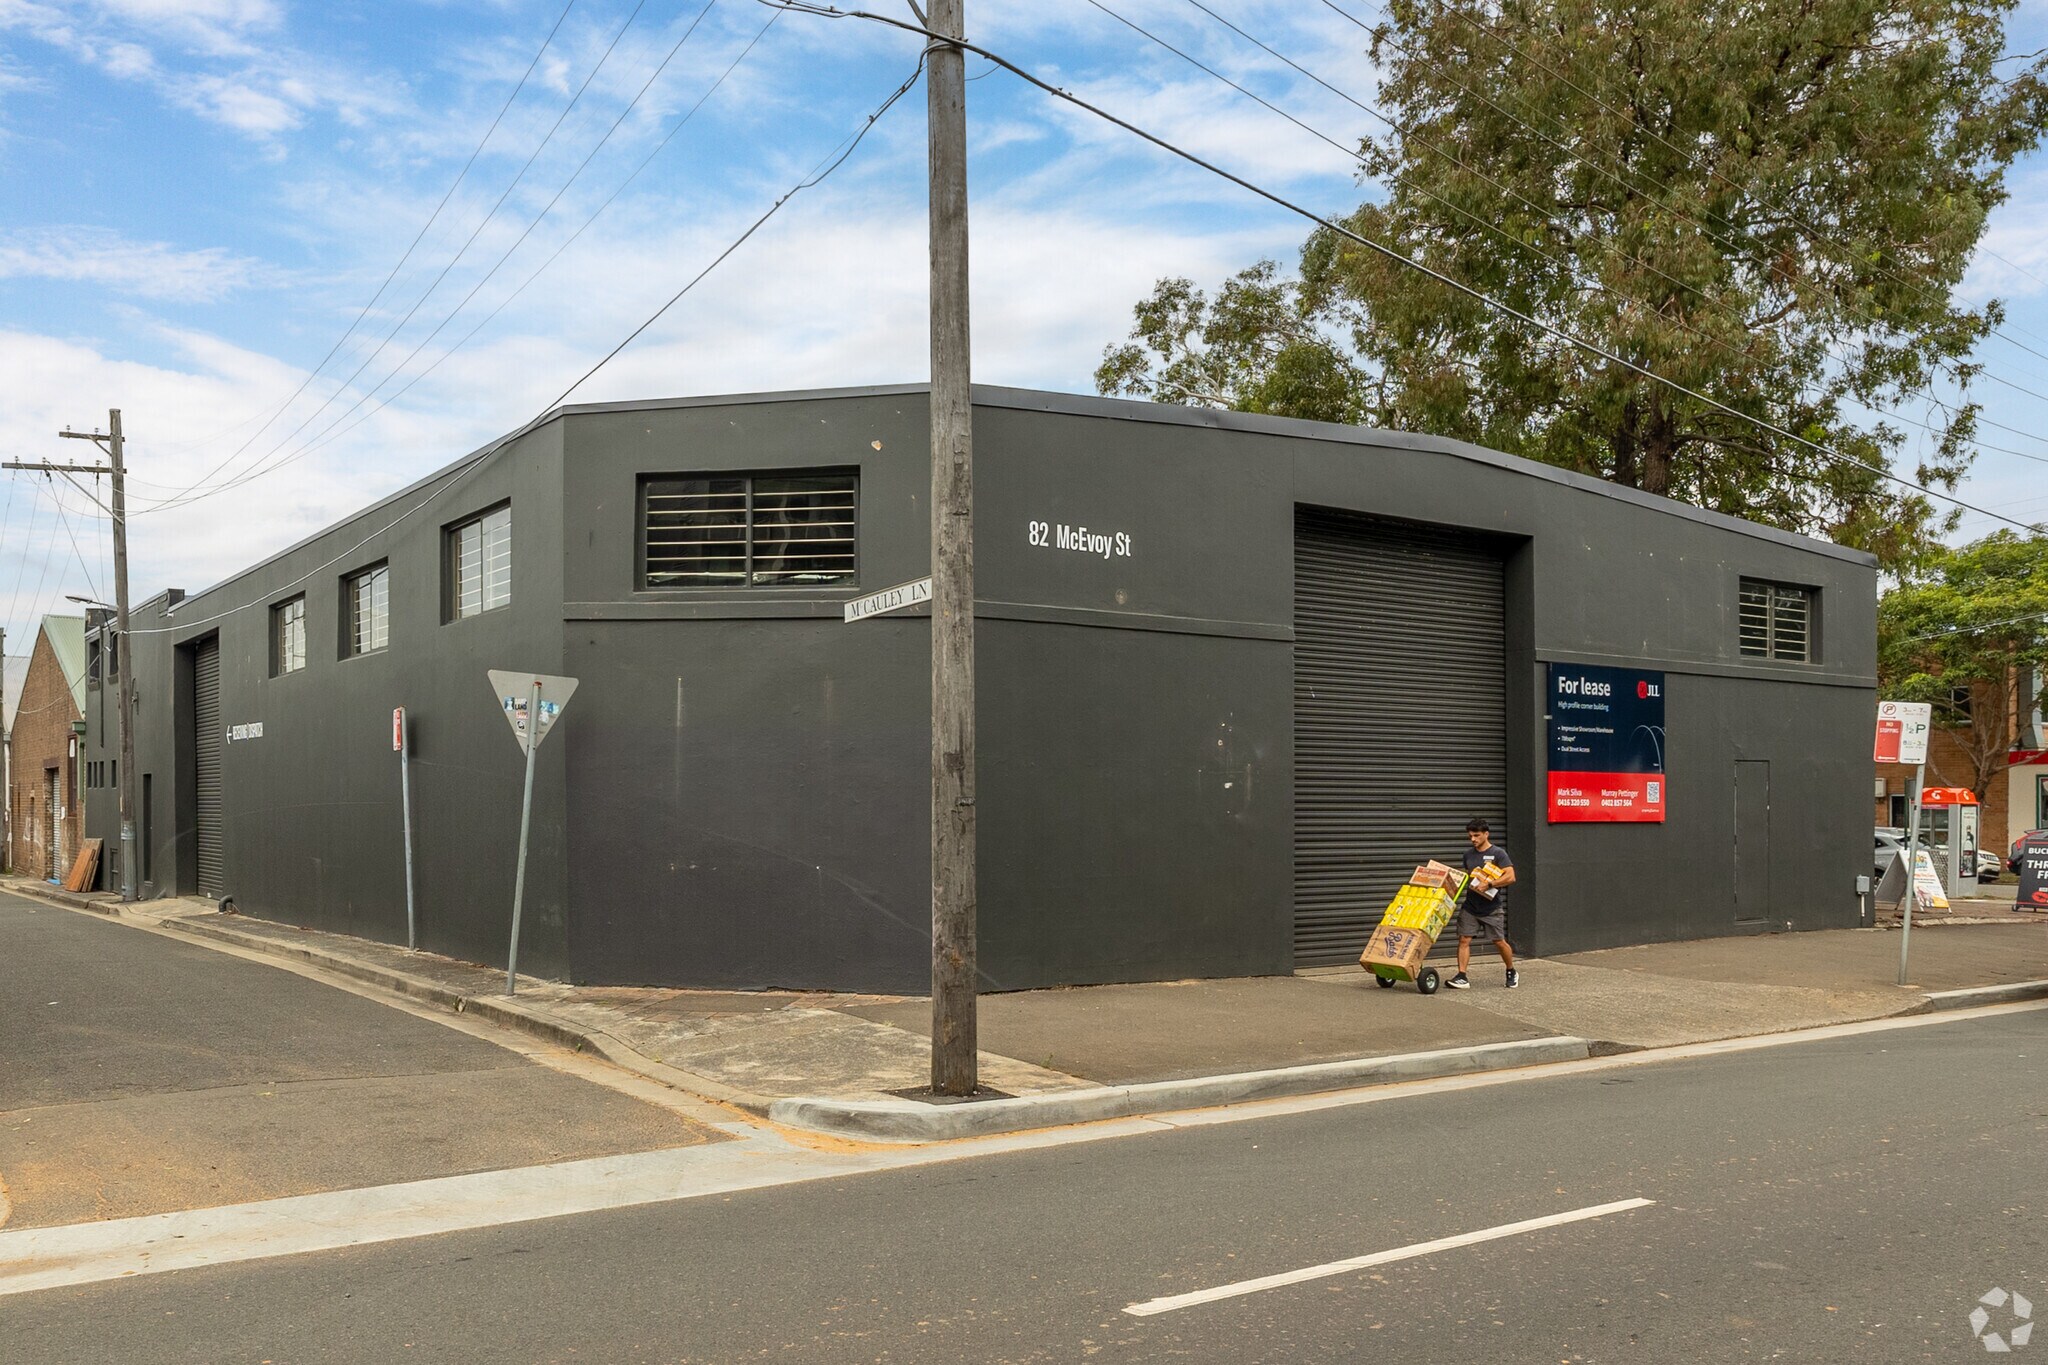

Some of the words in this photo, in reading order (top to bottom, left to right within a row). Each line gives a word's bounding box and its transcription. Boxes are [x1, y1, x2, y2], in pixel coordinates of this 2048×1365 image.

[1028, 520, 1049, 547] 82
[1056, 524, 1113, 560] McEvoy
[1115, 531, 1131, 557] St
[911, 581, 927, 601] LN
[1558, 676, 1579, 694] For
[1580, 676, 1611, 697] lease
[1647, 684, 1660, 697] JLL
[1557, 788, 1570, 796] Mark
[1570, 788, 1583, 796] Silva
[1601, 789, 1617, 798] Murray
